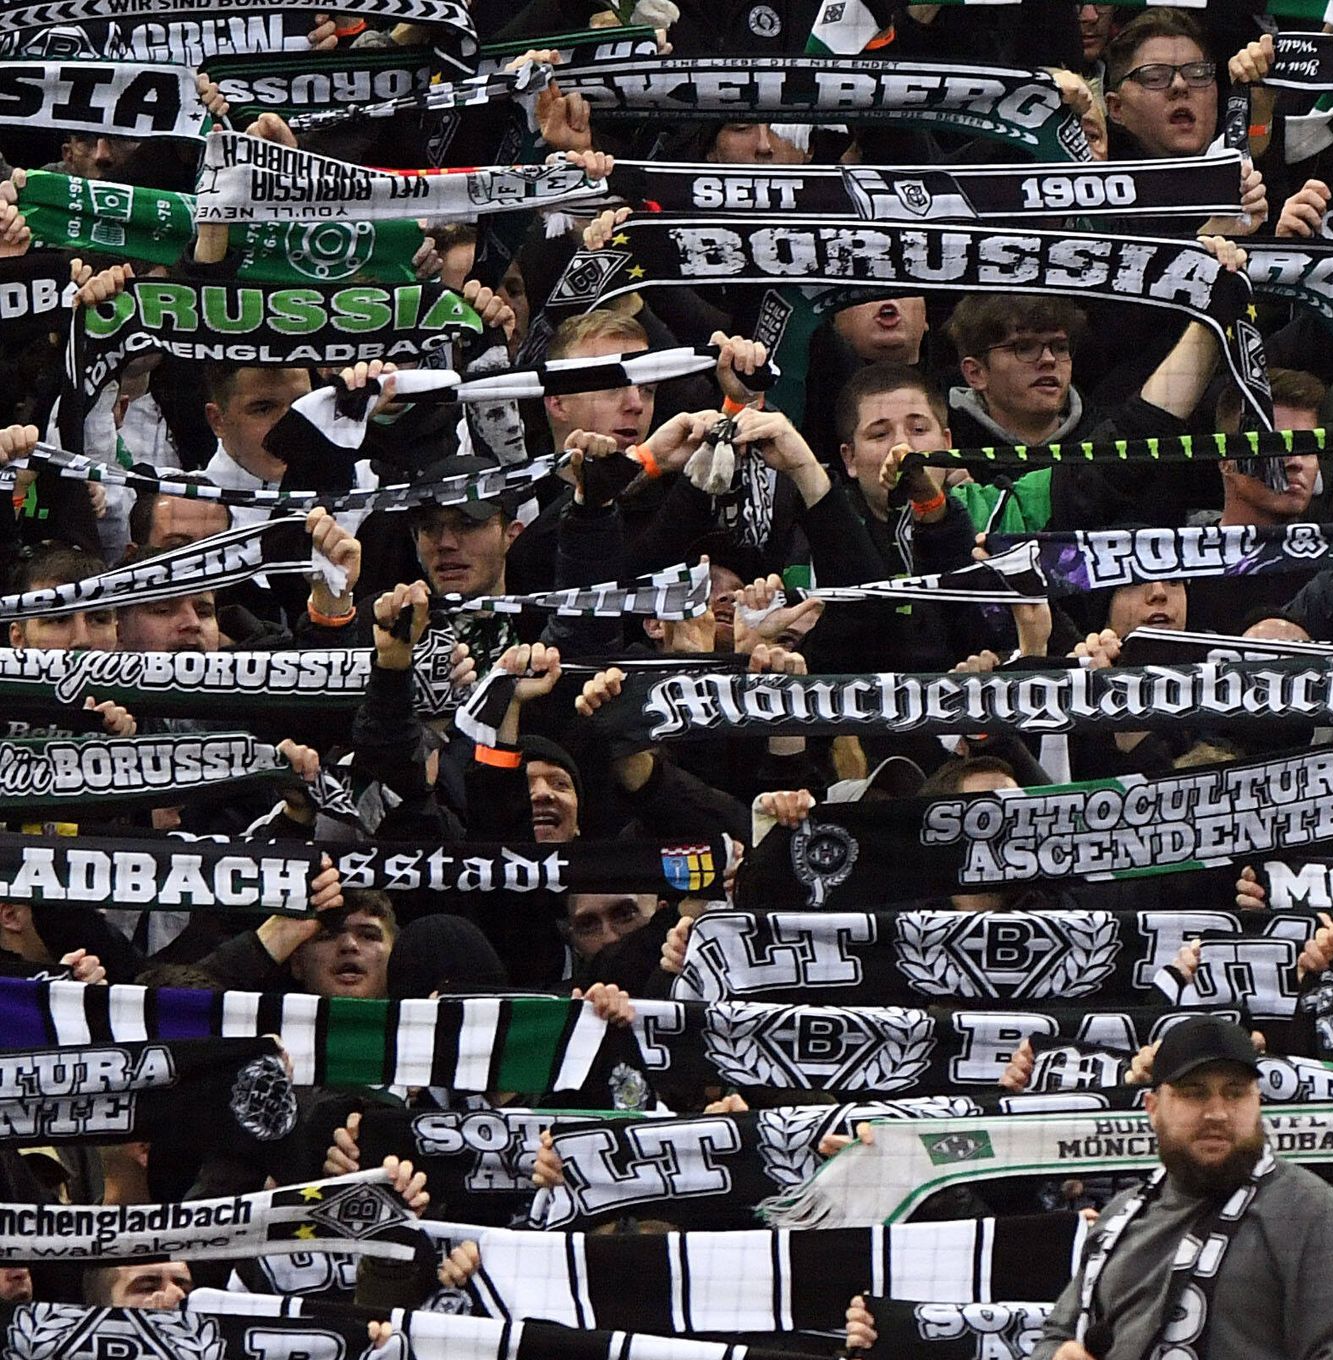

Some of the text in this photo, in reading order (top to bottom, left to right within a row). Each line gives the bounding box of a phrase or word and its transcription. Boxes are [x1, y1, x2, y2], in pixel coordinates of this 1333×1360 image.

[692, 174, 1137, 209] SEIT 1900
[669, 226, 1219, 307] BORUSSIA
